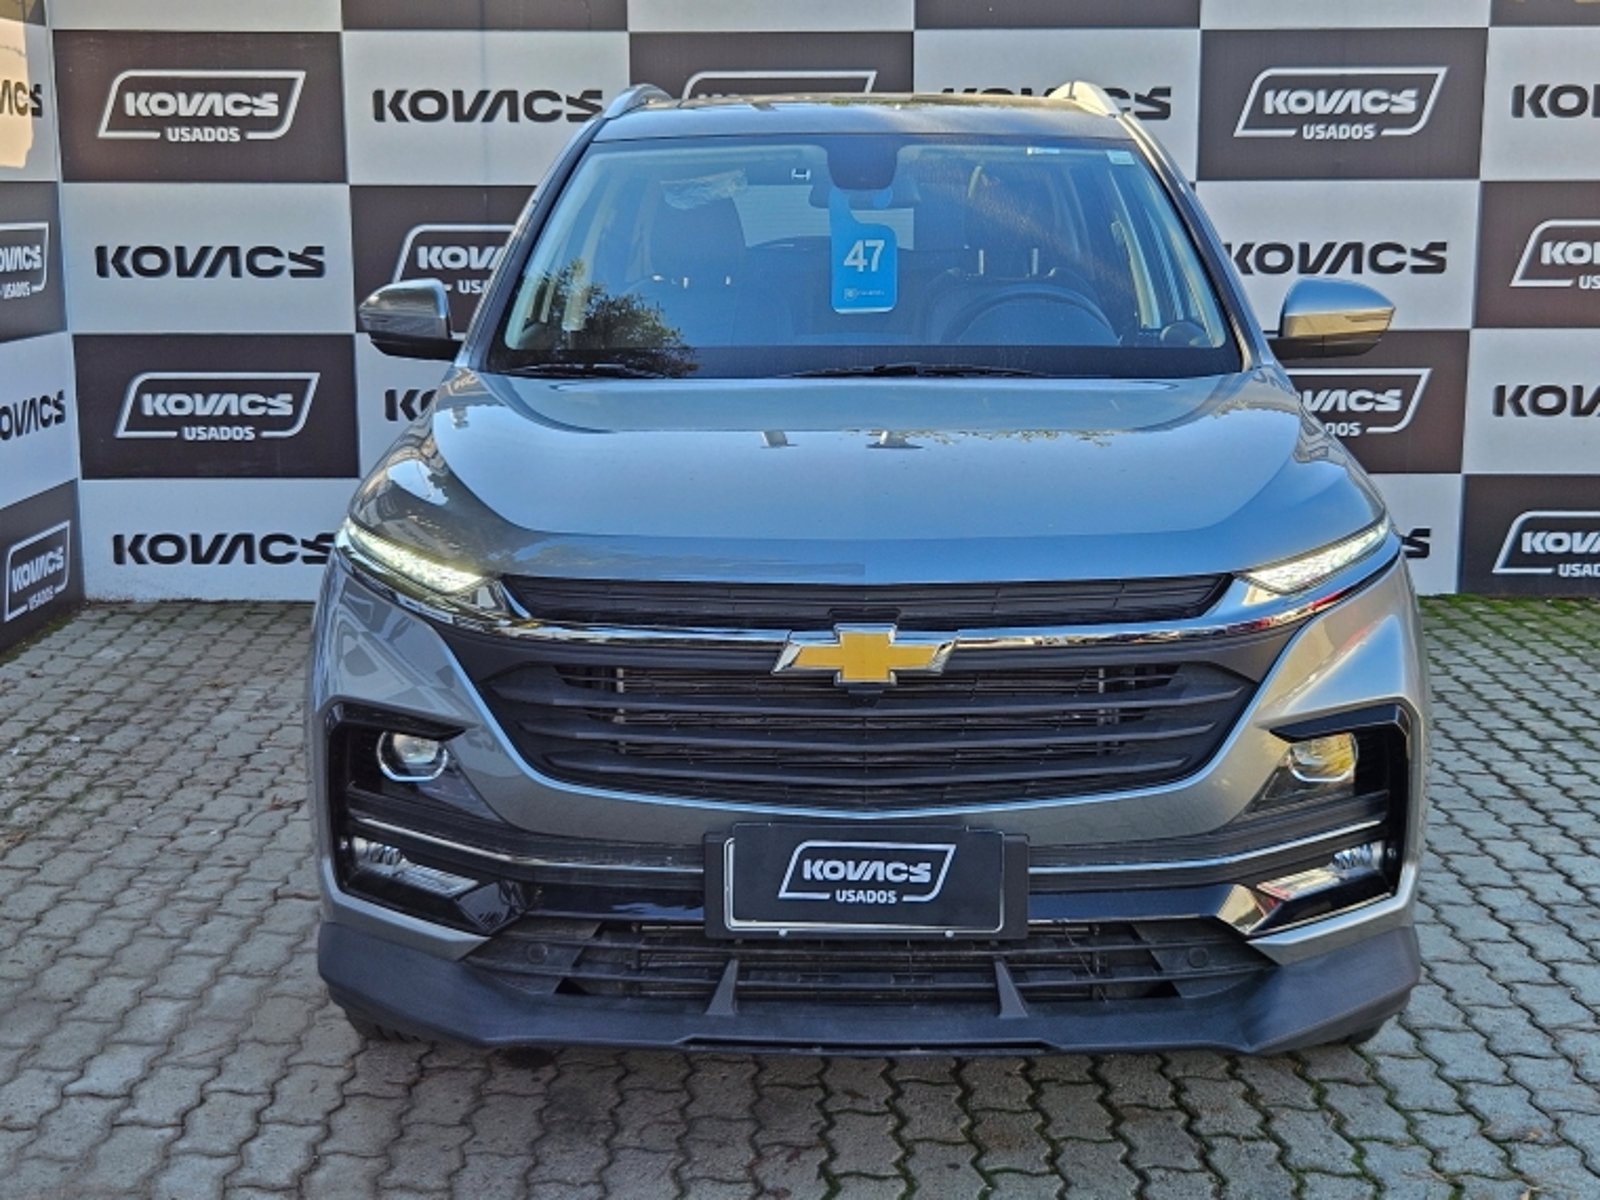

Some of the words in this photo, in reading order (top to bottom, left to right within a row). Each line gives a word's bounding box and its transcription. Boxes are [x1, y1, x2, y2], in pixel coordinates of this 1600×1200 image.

[0, 79, 42, 118] ACS
[124, 91, 279, 118] KOVACS
[373, 89, 604, 123] KOVACS
[1263, 88, 1418, 115] KOVACS
[165, 127, 241, 142] USADOS
[1302, 124, 1376, 140] USADOS
[96, 245, 325, 278] KOVACS
[843, 239, 885, 272] 47
[1224, 242, 1448, 274] KOVACS
[142, 391, 293, 416] KOVACS
[183, 426, 255, 441] USADOS
[113, 533, 338, 565] KOVACS
[12, 546, 64, 593] KOVACS
[803, 859, 932, 883] KOVACS
[835, 889, 897, 904] USADOS
